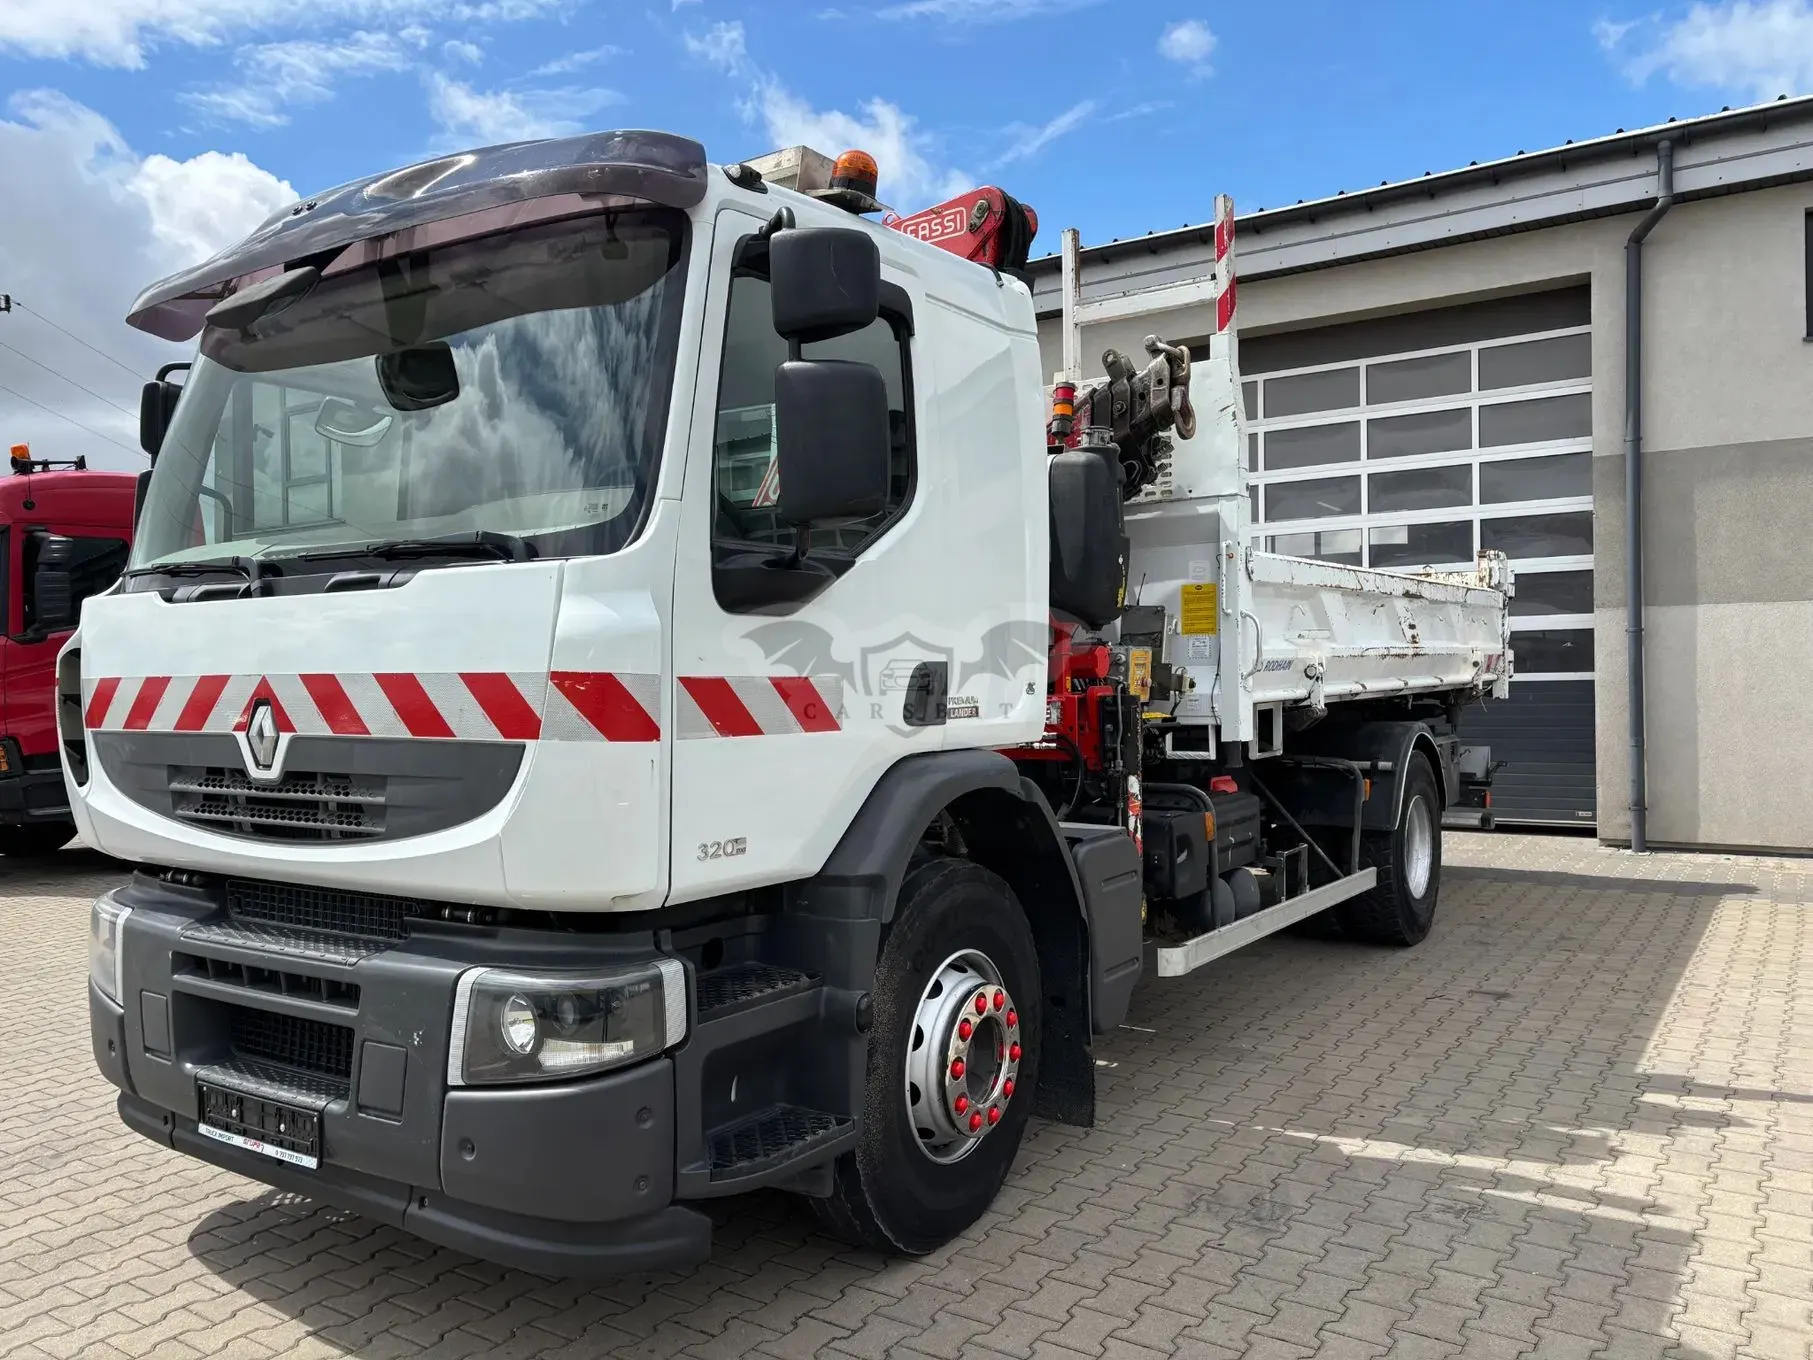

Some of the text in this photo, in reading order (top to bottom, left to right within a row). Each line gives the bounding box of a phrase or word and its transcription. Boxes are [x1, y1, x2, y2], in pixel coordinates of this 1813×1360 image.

[906, 214, 960, 240] FASSI
[949, 706, 977, 718] LANDER
[697, 840, 735, 861] 320
